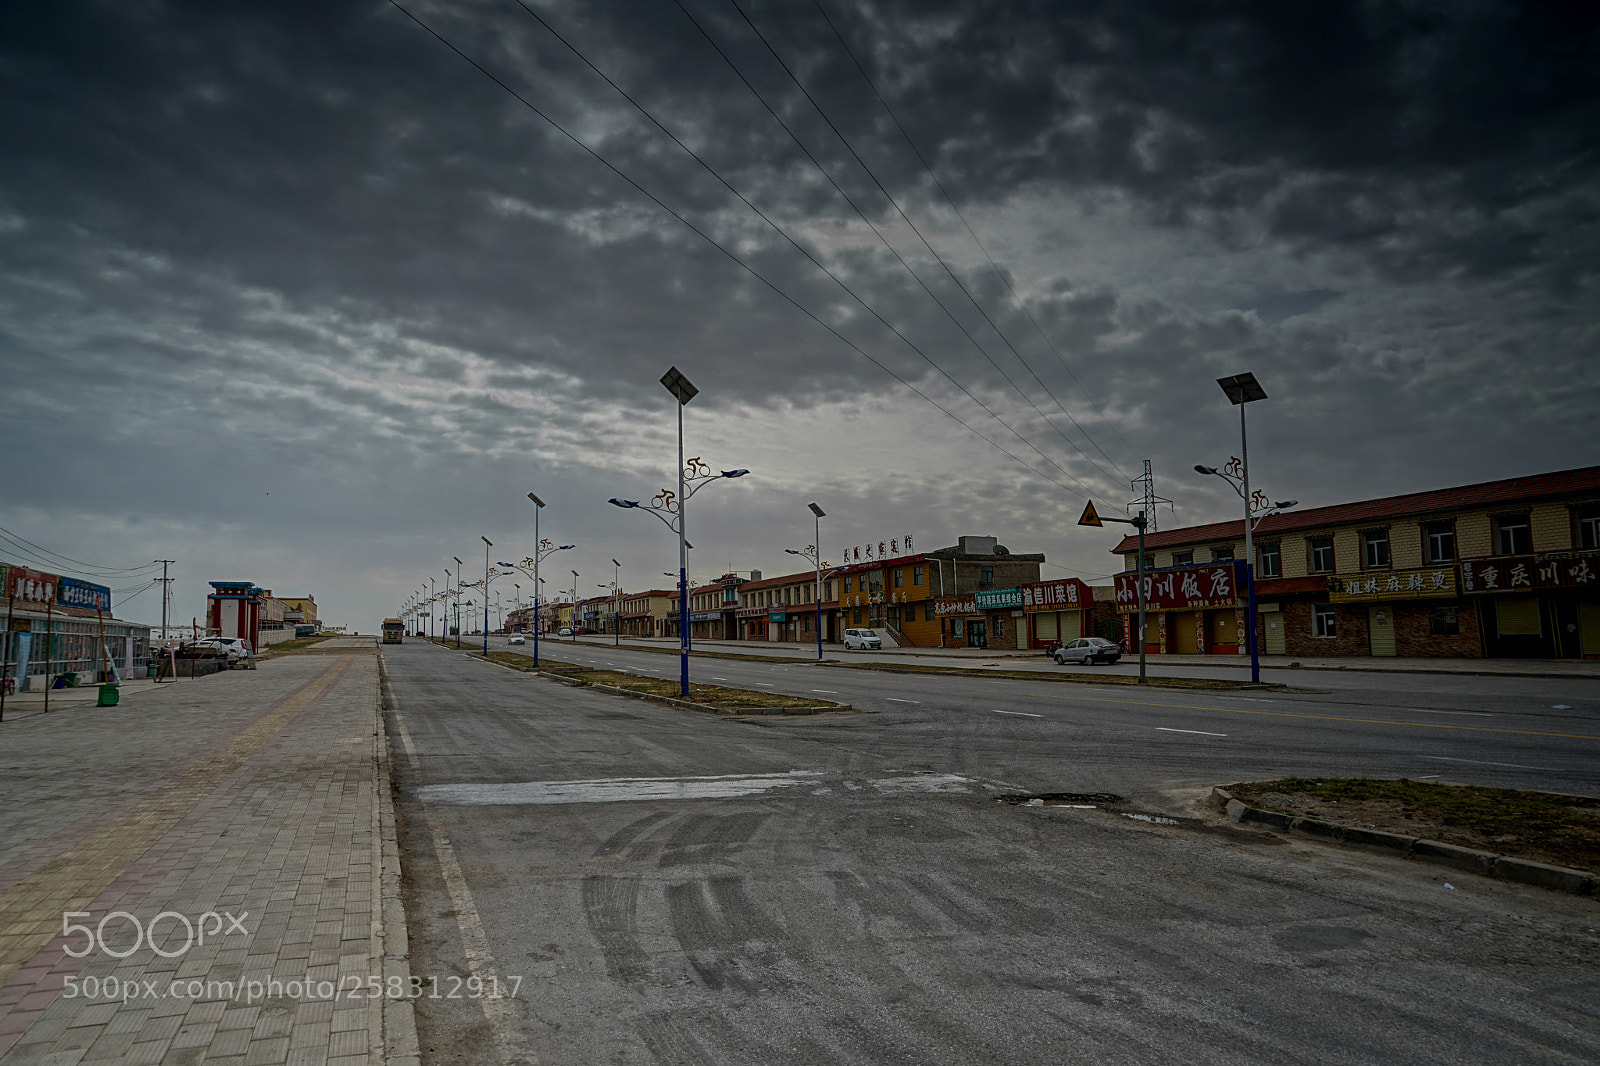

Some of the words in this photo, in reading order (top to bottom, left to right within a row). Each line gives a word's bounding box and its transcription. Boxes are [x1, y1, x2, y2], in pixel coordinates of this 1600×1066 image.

[1116, 568, 1232, 603] 小四川饭店
[1346, 570, 1451, 596] 姐妹麻辣烫
[1479, 559, 1596, 589] 重庆川味
[1023, 583, 1078, 606] 渝信川菜馆
